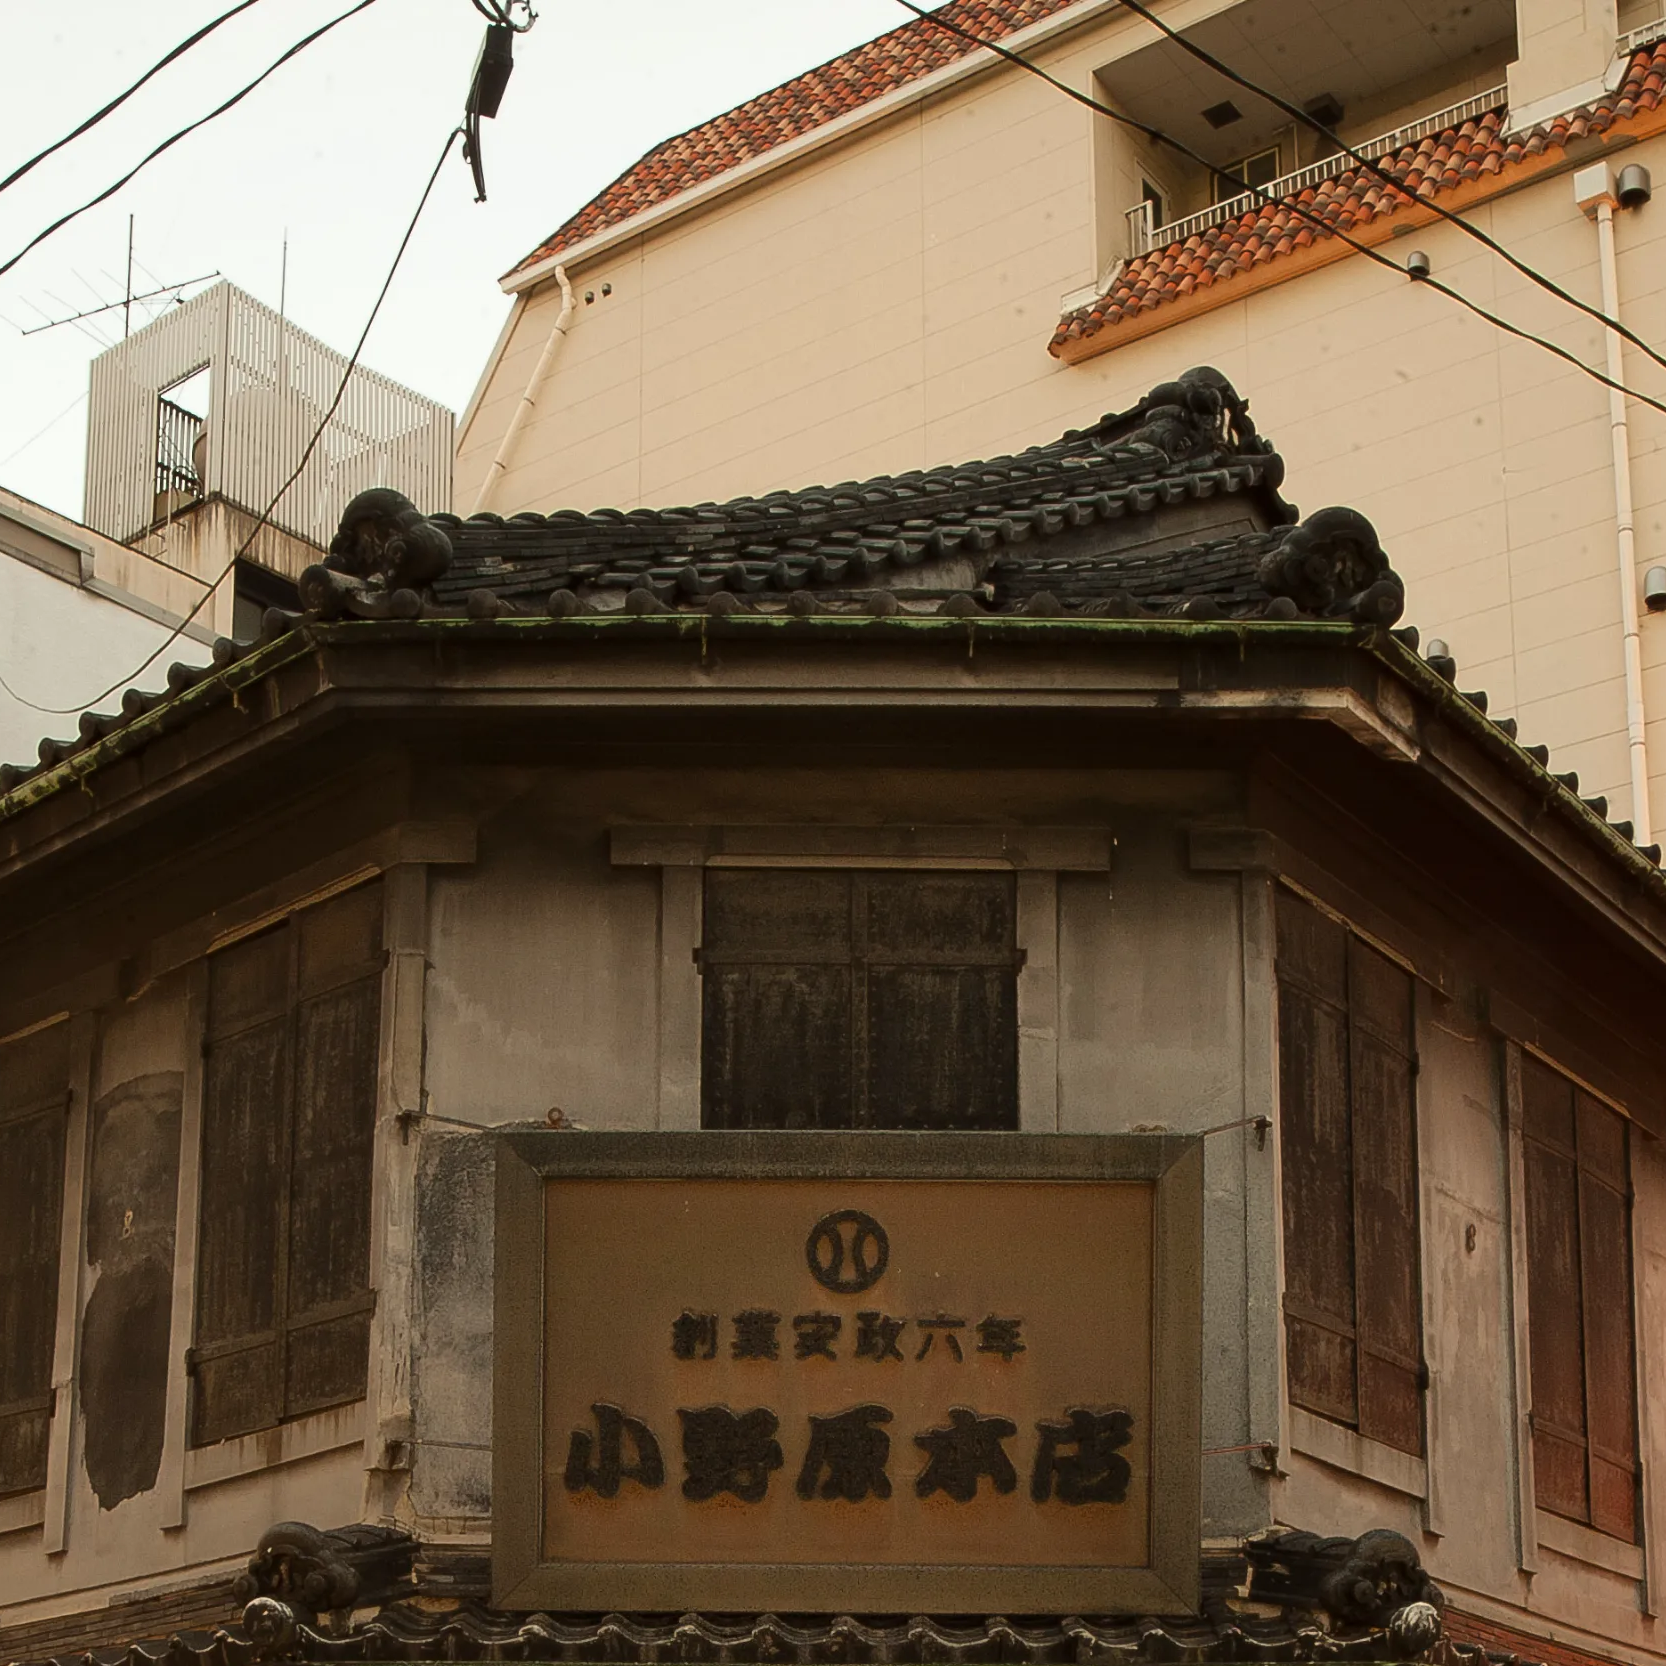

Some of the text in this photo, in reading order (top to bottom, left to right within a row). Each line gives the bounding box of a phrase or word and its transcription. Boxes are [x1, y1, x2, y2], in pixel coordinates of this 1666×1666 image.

[671, 1310, 1026, 1361] 創業安政六年
[562, 1402, 1135, 1505] 小野原本店
